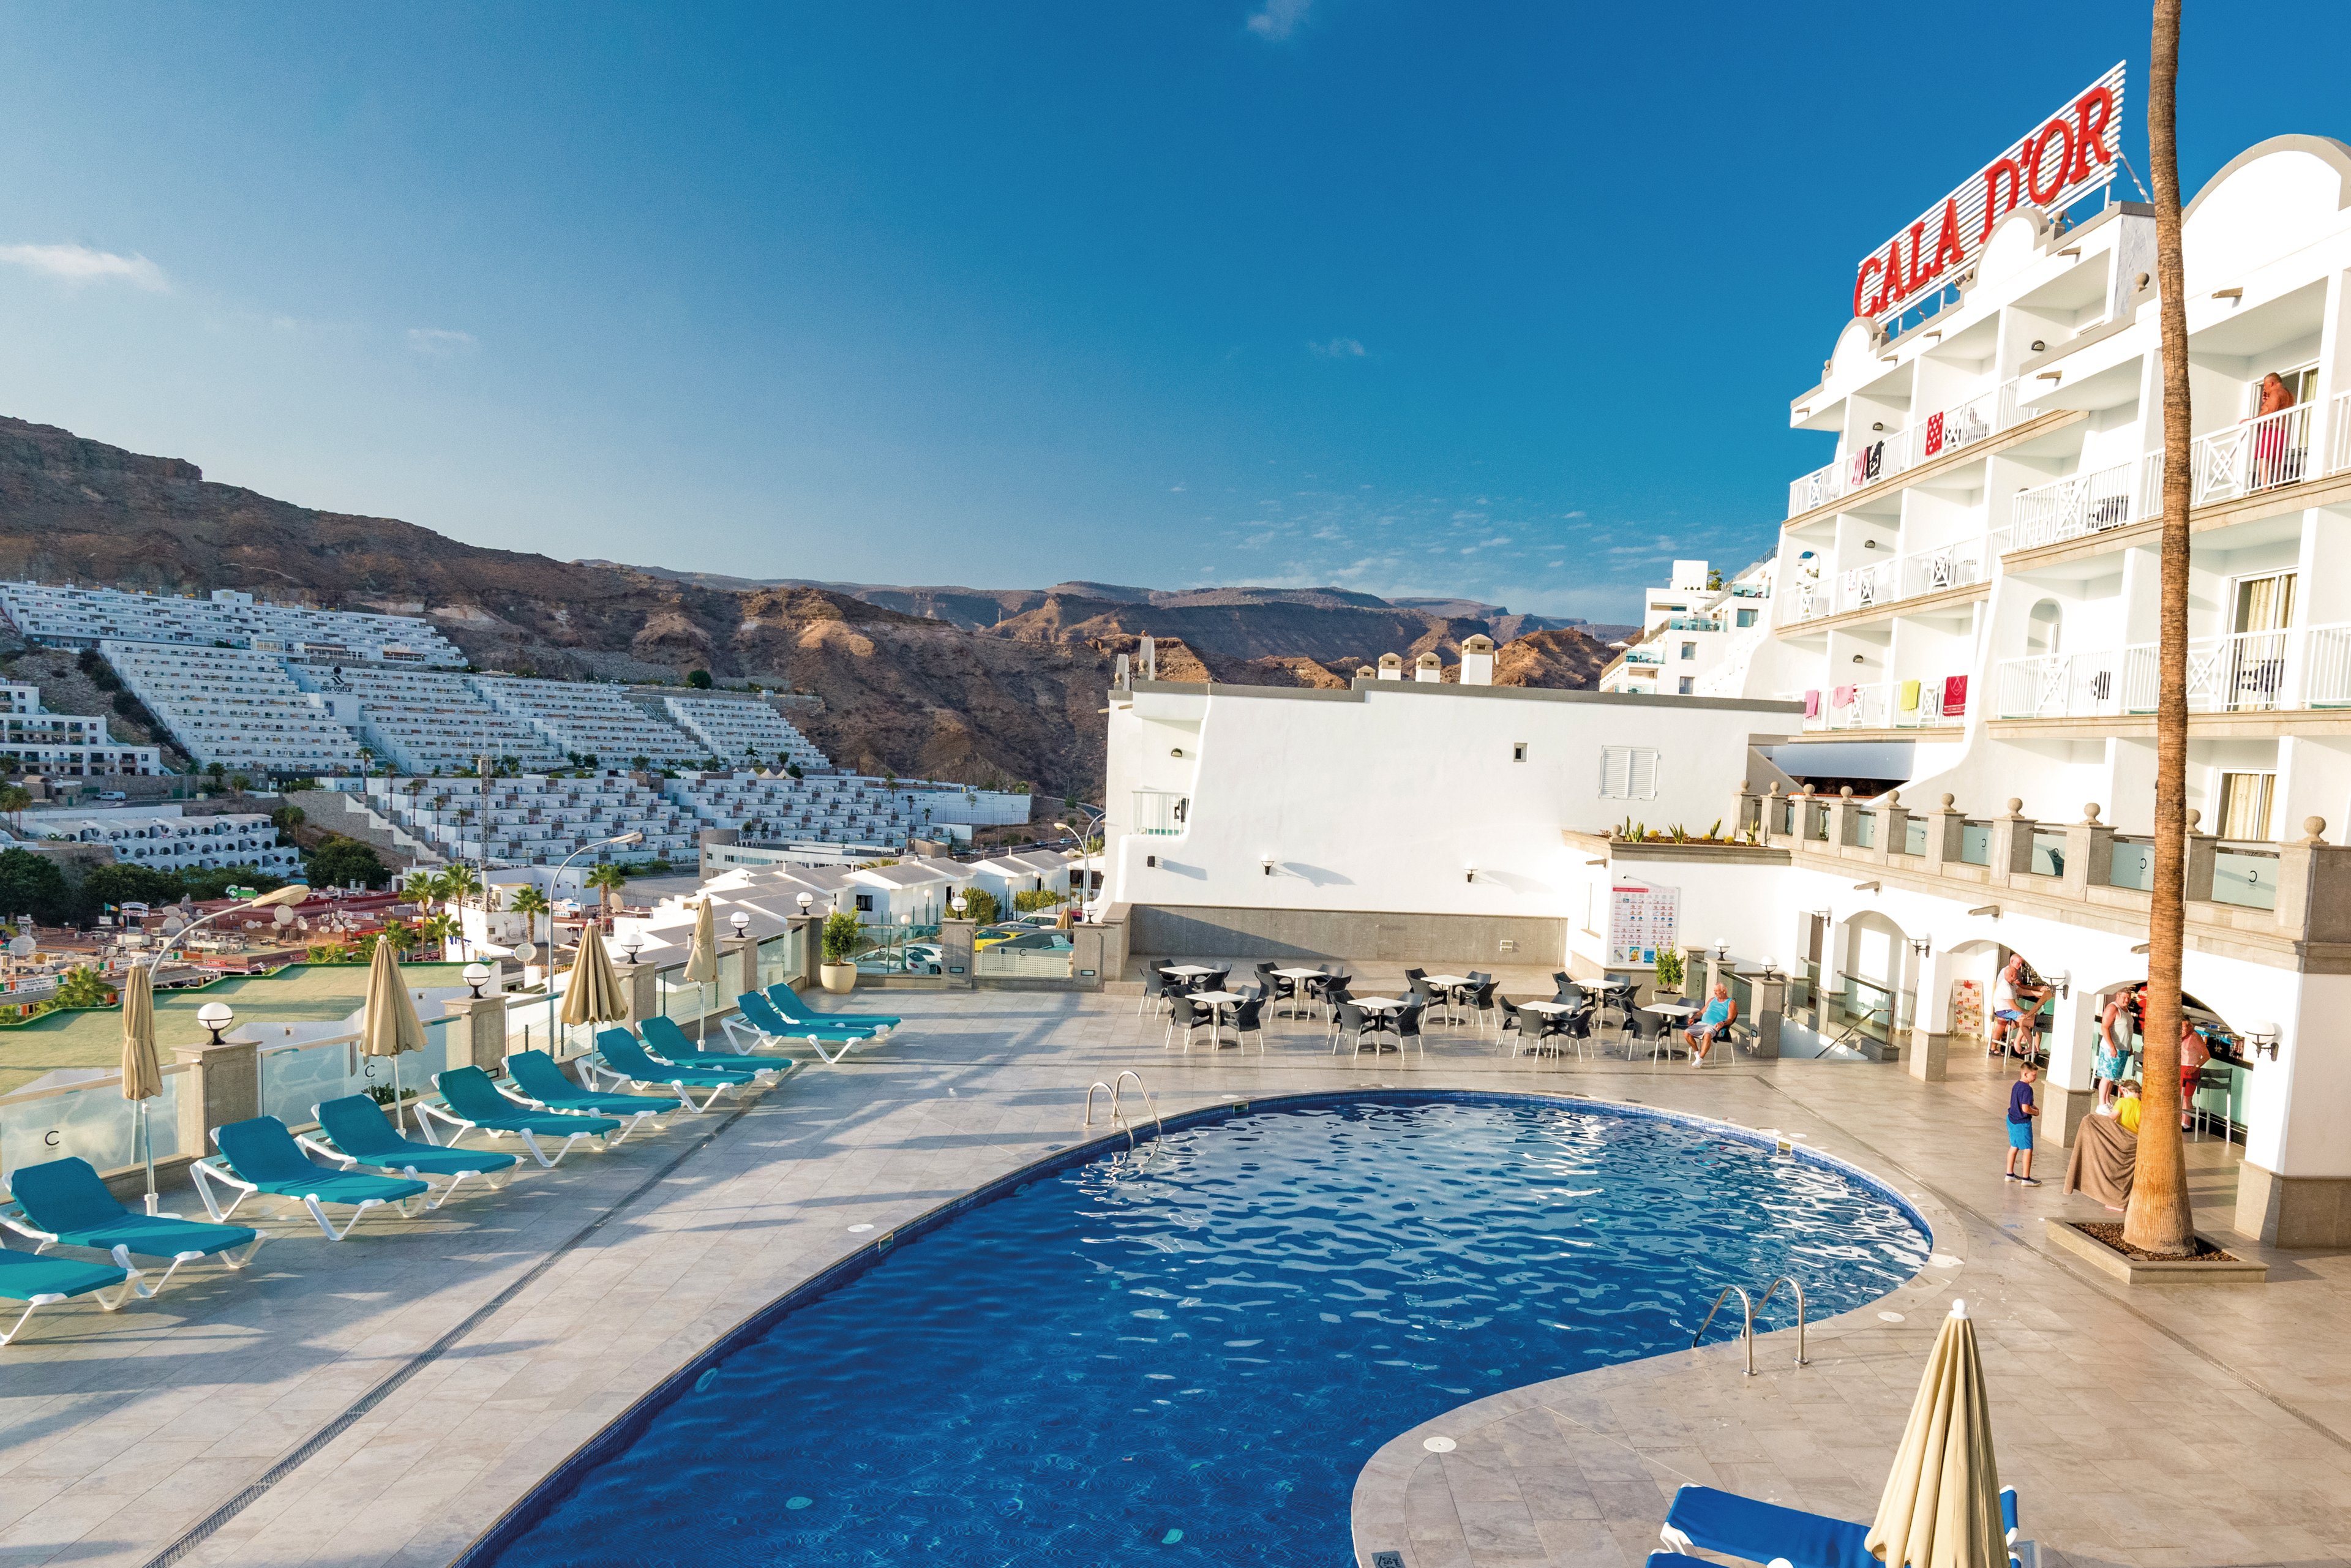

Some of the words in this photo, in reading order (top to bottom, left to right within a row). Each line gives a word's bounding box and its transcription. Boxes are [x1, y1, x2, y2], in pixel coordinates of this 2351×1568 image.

[1854, 198, 1964, 317] CALA
[1979, 86, 2112, 244] D'OR
[45, 1130, 59, 1146] C
